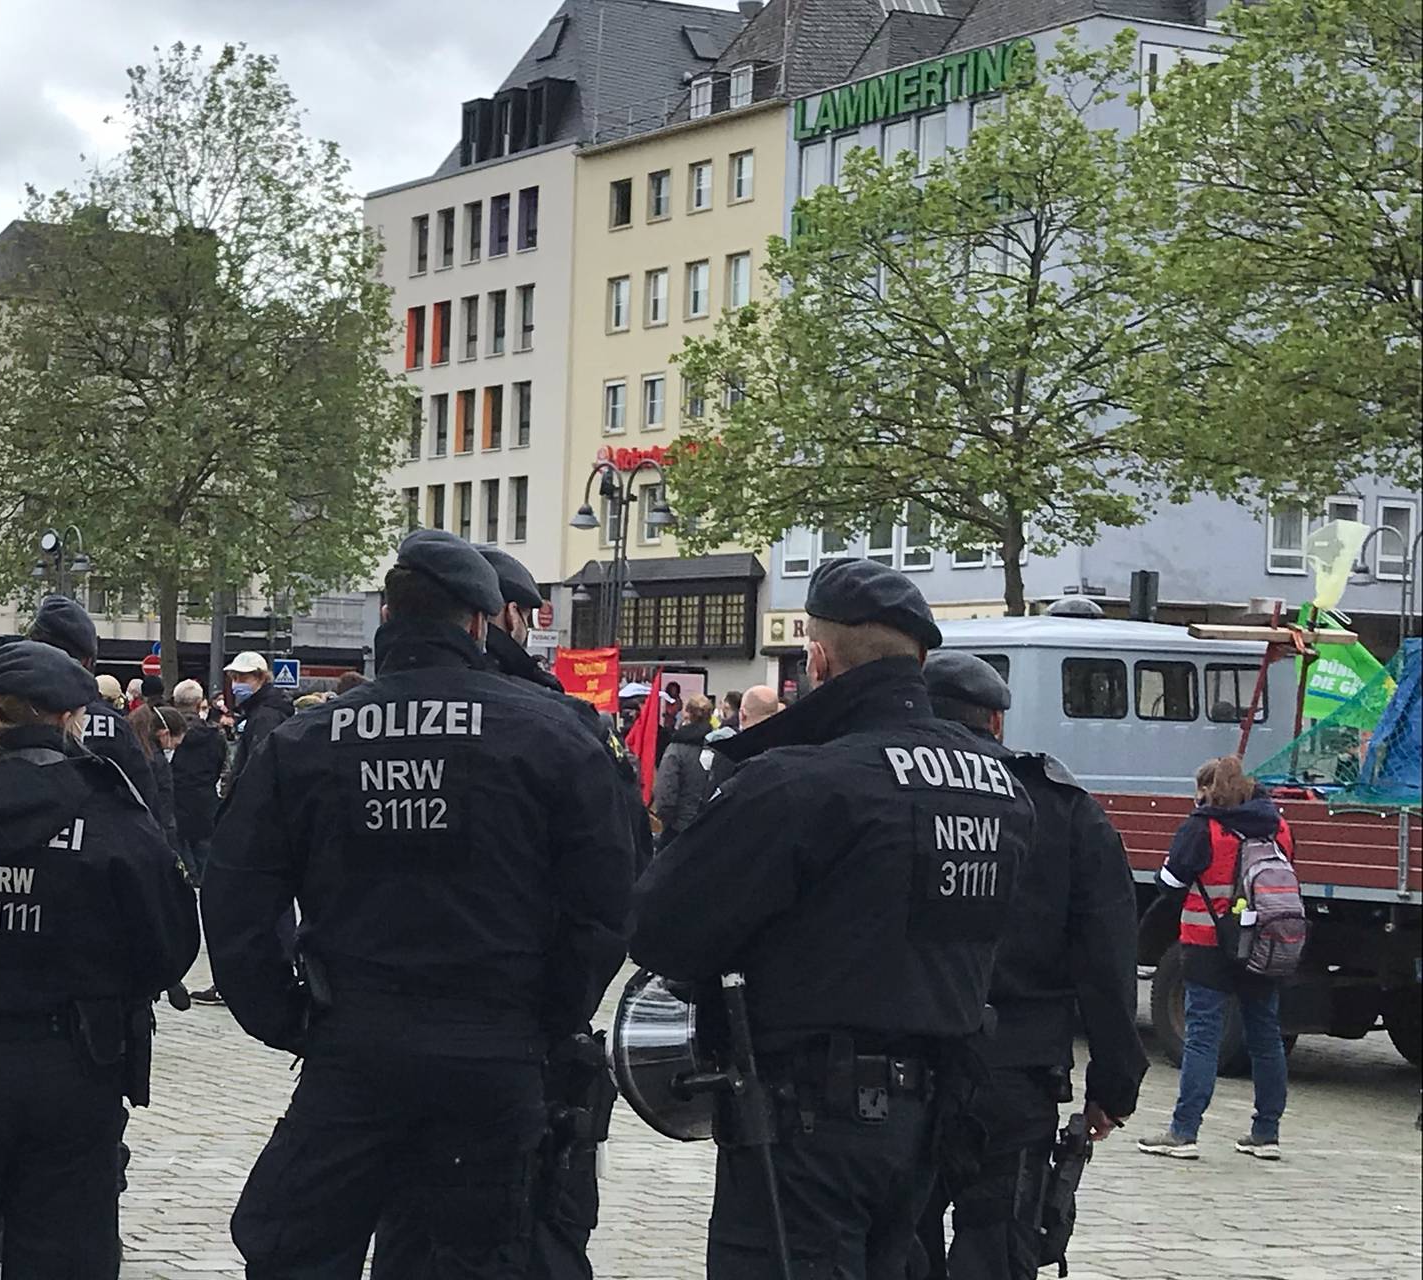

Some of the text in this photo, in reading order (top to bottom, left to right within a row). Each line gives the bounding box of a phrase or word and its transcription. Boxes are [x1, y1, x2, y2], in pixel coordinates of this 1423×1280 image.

[794, 37, 1037, 141] LAMMERTING
[1309, 674, 1336, 690] DIE
[330, 700, 482, 742] POLIZEI
[360, 759, 445, 792] NRW
[884, 746, 1016, 799] POLIZEI
[365, 797, 448, 830] 31112
[934, 815, 1000, 852] NRW
[939, 861, 998, 897] 31111
